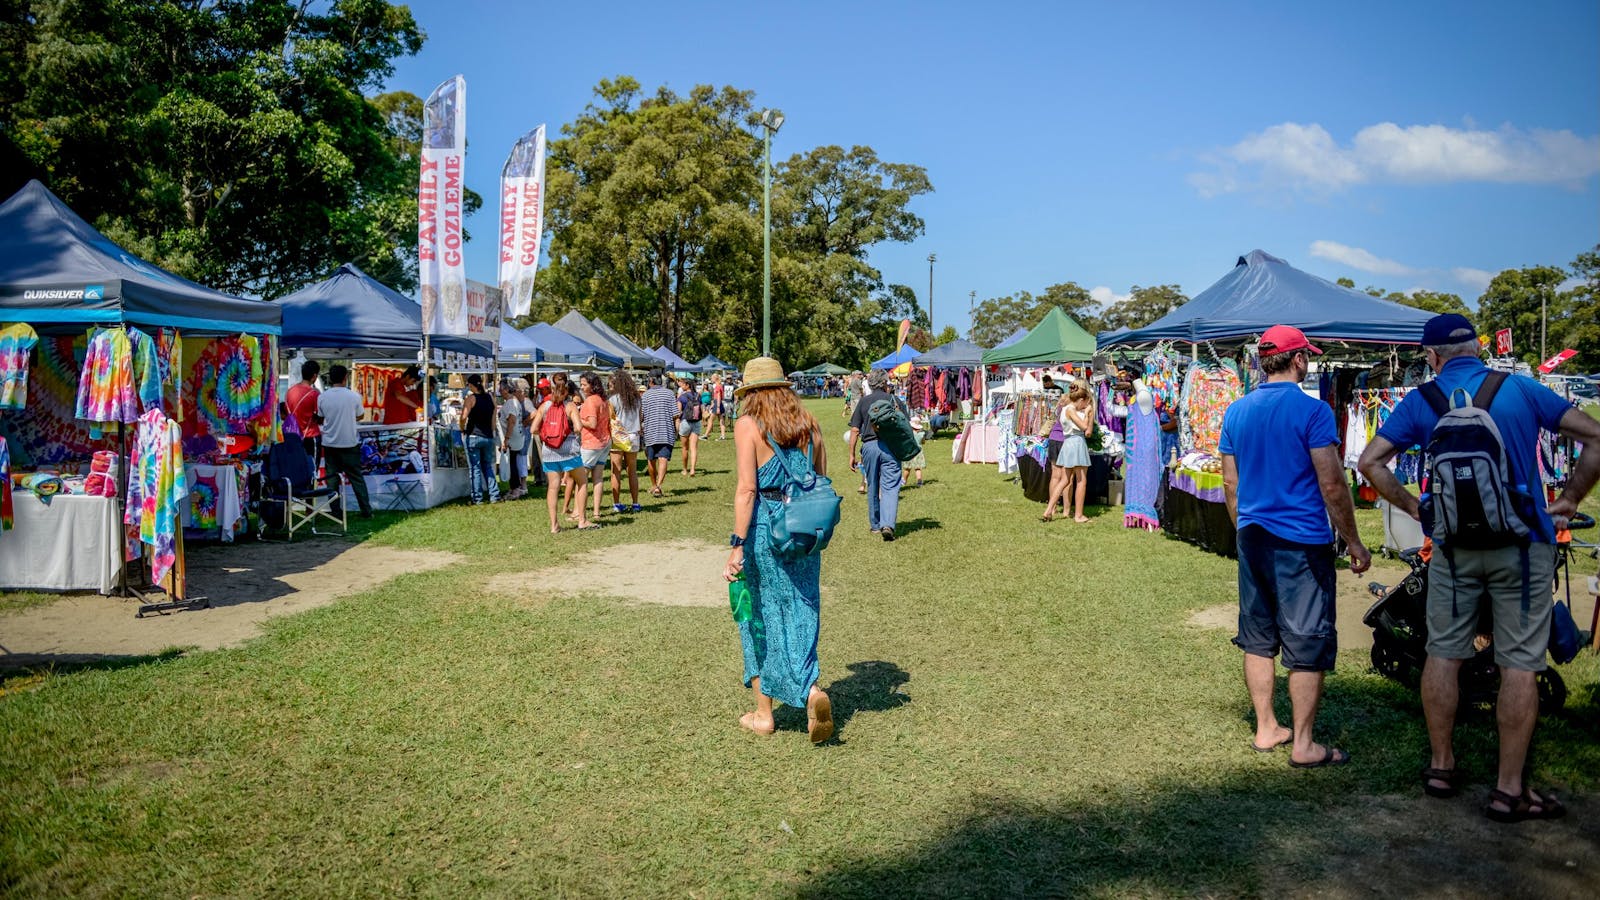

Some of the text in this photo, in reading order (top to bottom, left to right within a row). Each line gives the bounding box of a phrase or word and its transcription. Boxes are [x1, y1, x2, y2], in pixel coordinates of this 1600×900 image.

[418, 155, 438, 262] FAMILY
[444, 155, 461, 267] GOZLEME
[501, 183, 518, 264] FAMILY
[520, 182, 540, 266] GOZLEME
[23, 289, 84, 300] QUIKSILVER
